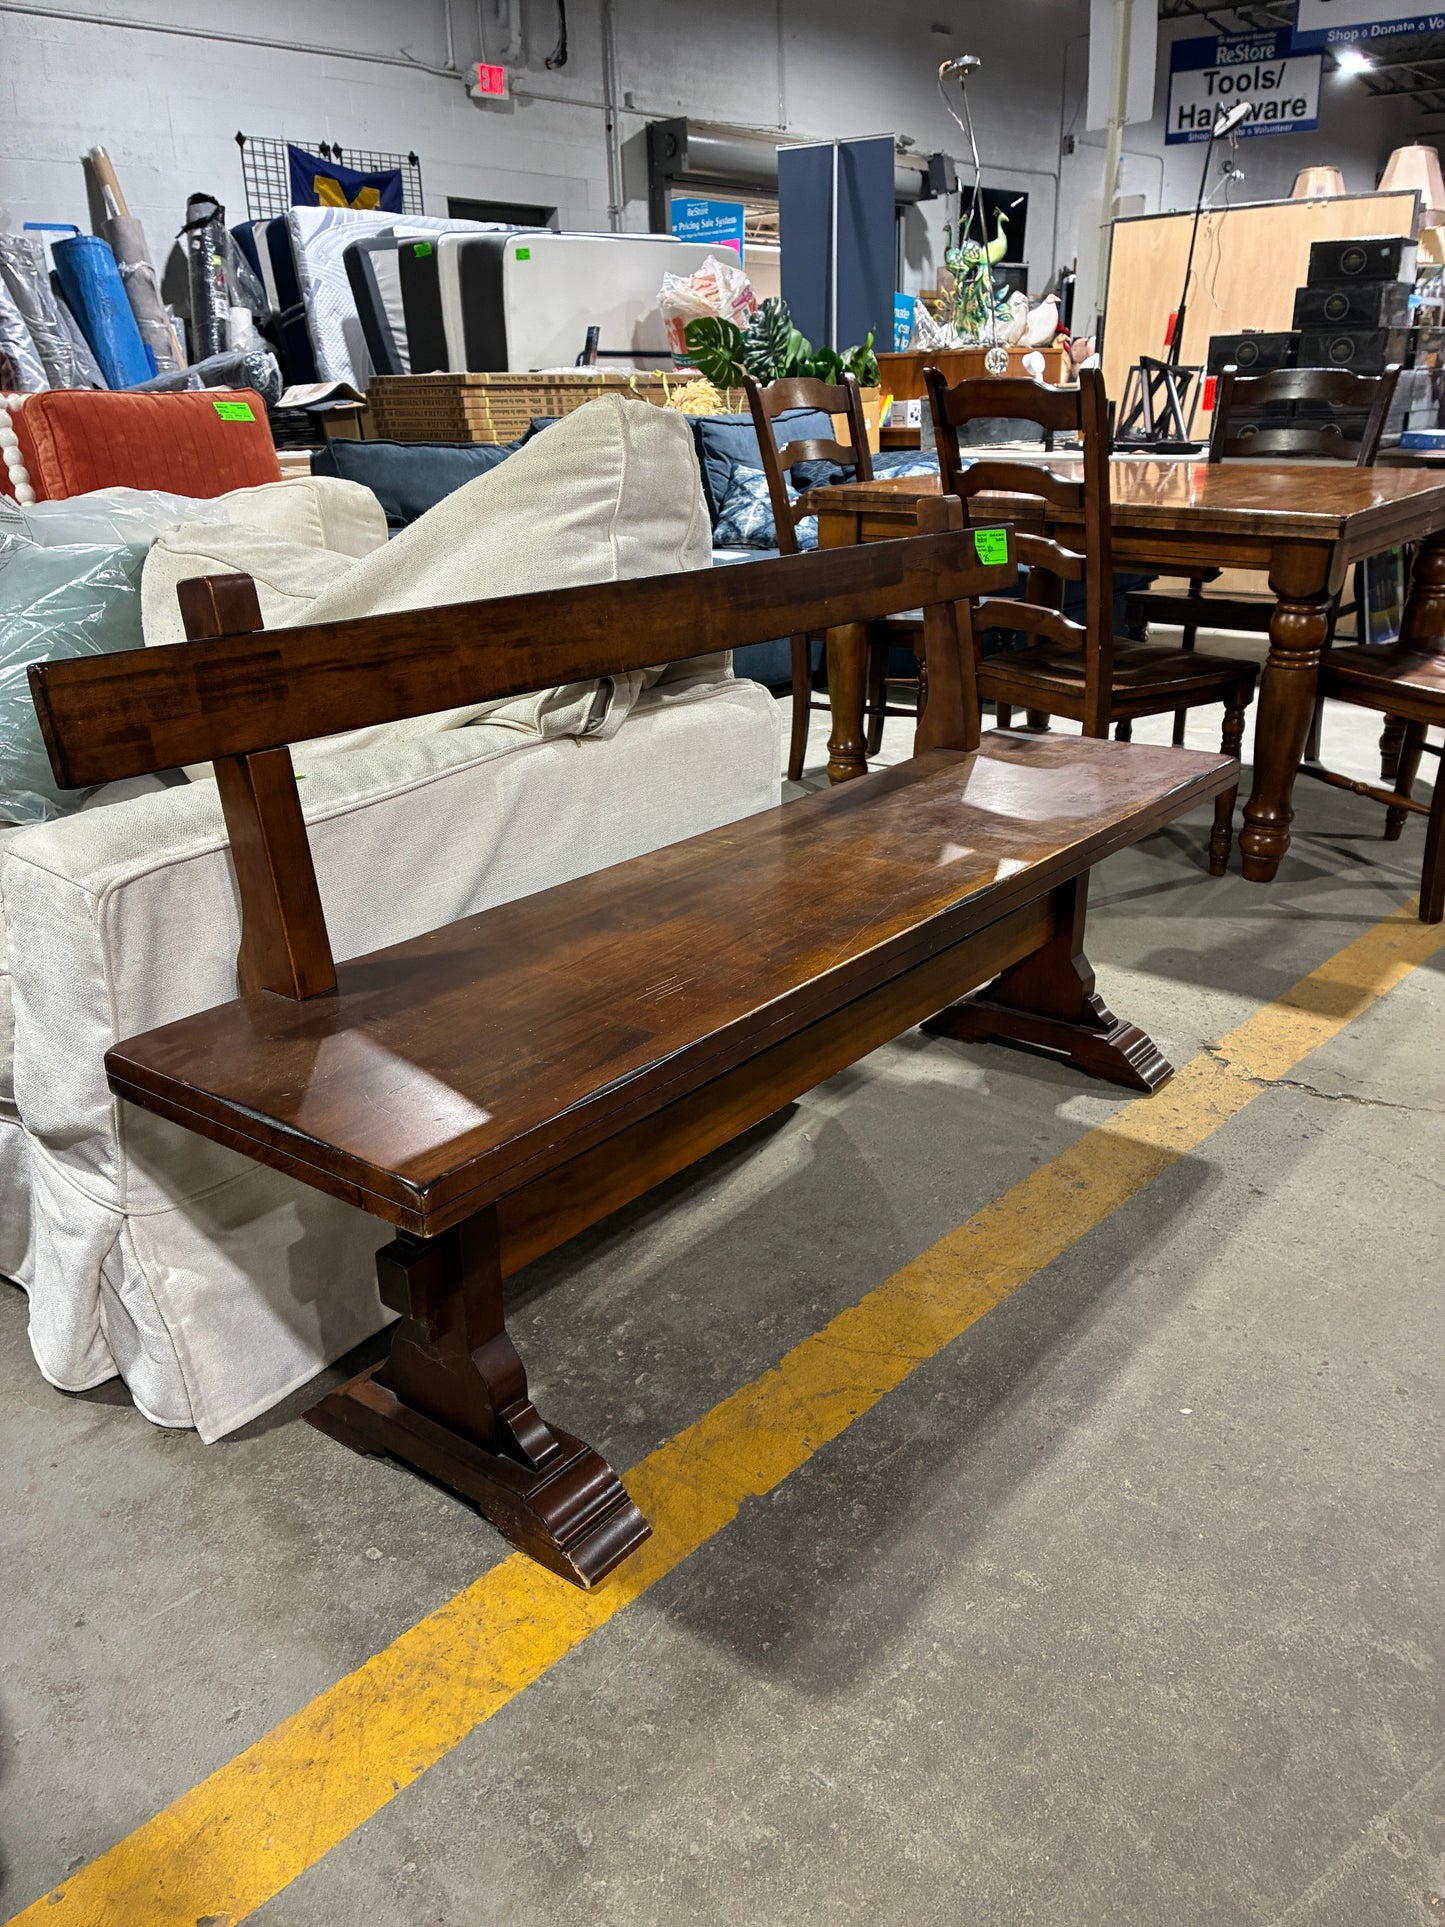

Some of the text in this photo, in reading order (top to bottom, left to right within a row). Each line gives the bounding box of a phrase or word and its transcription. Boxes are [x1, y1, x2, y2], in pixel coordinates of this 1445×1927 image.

[1327, 30, 1359, 42] Shop
[1216, 44, 1275, 64] ReStore
[1204, 61, 1286, 96] Tools/
